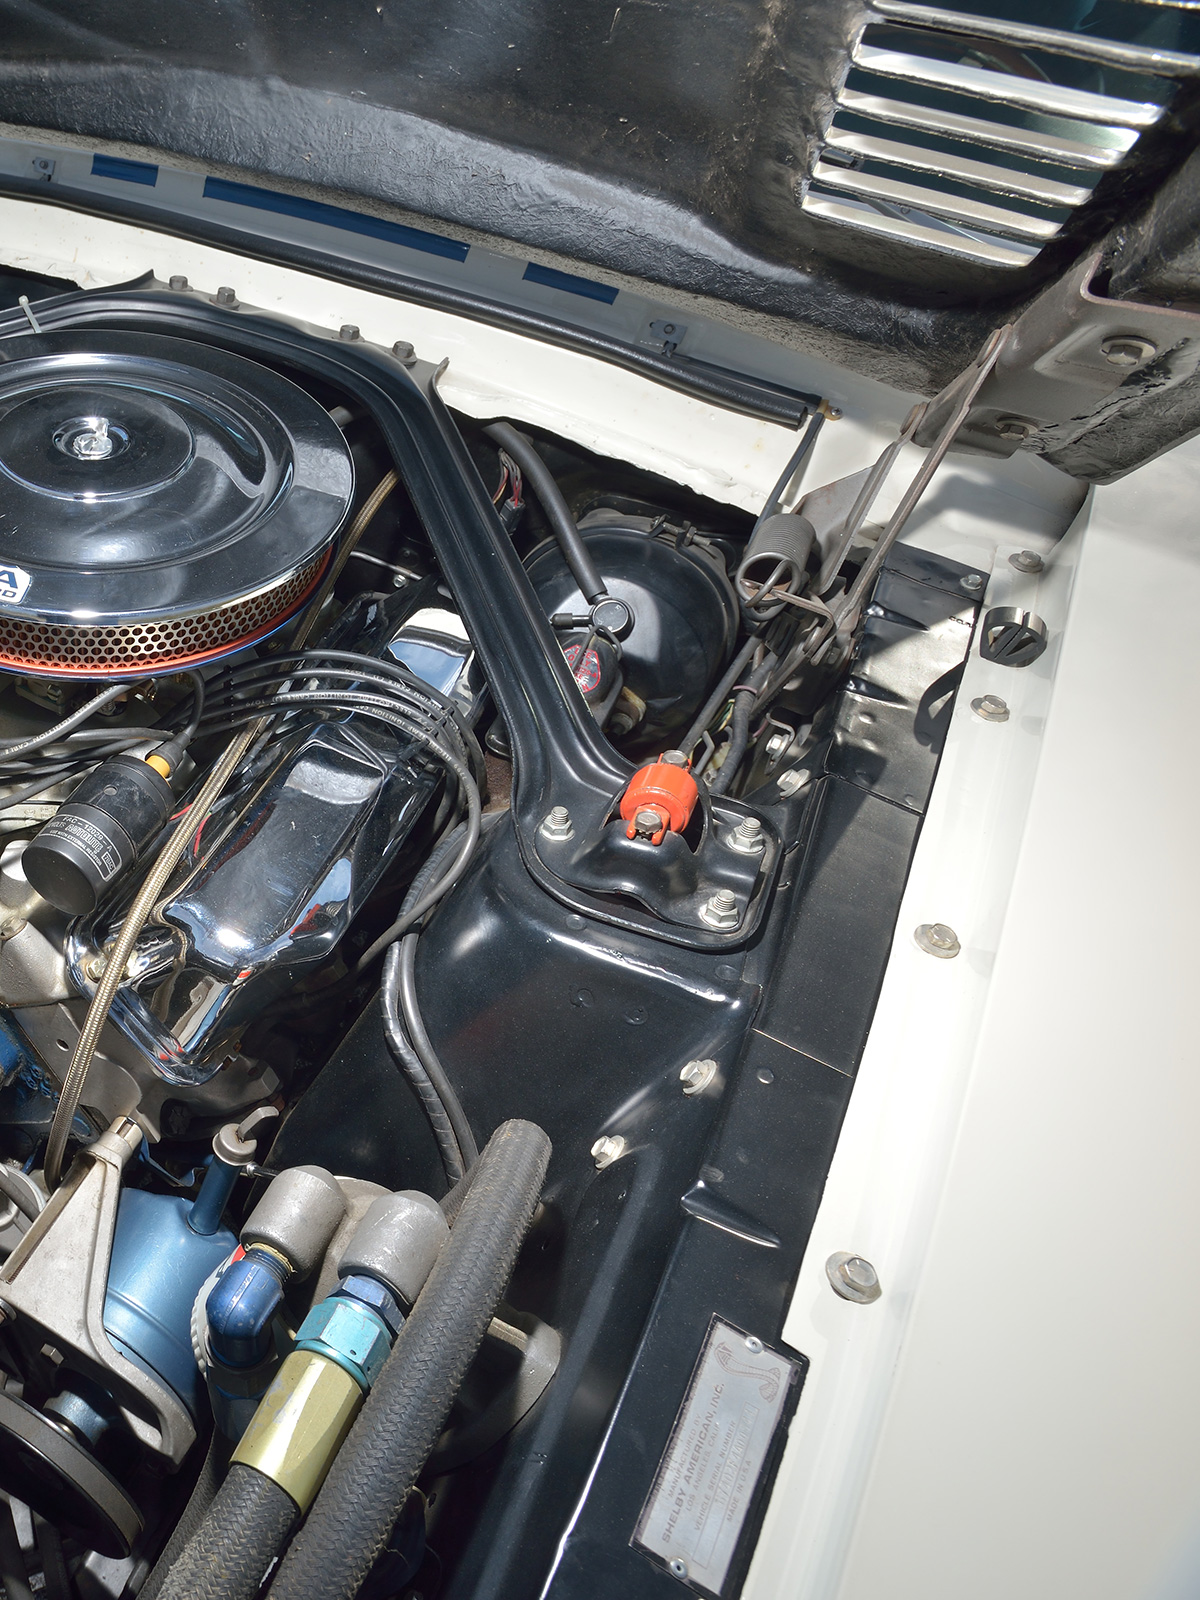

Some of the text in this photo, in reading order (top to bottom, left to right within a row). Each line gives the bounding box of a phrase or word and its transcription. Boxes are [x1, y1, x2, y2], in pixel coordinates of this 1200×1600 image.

[661, 1488, 687, 1543] SHELBY
[682, 1408, 718, 1484] AMERICAN,
[686, 1493, 695, 1511] LOS
[694, 1420, 736, 1530] VEHICLE SERIAL NUMBER
[726, 1495, 739, 1522] MADE
